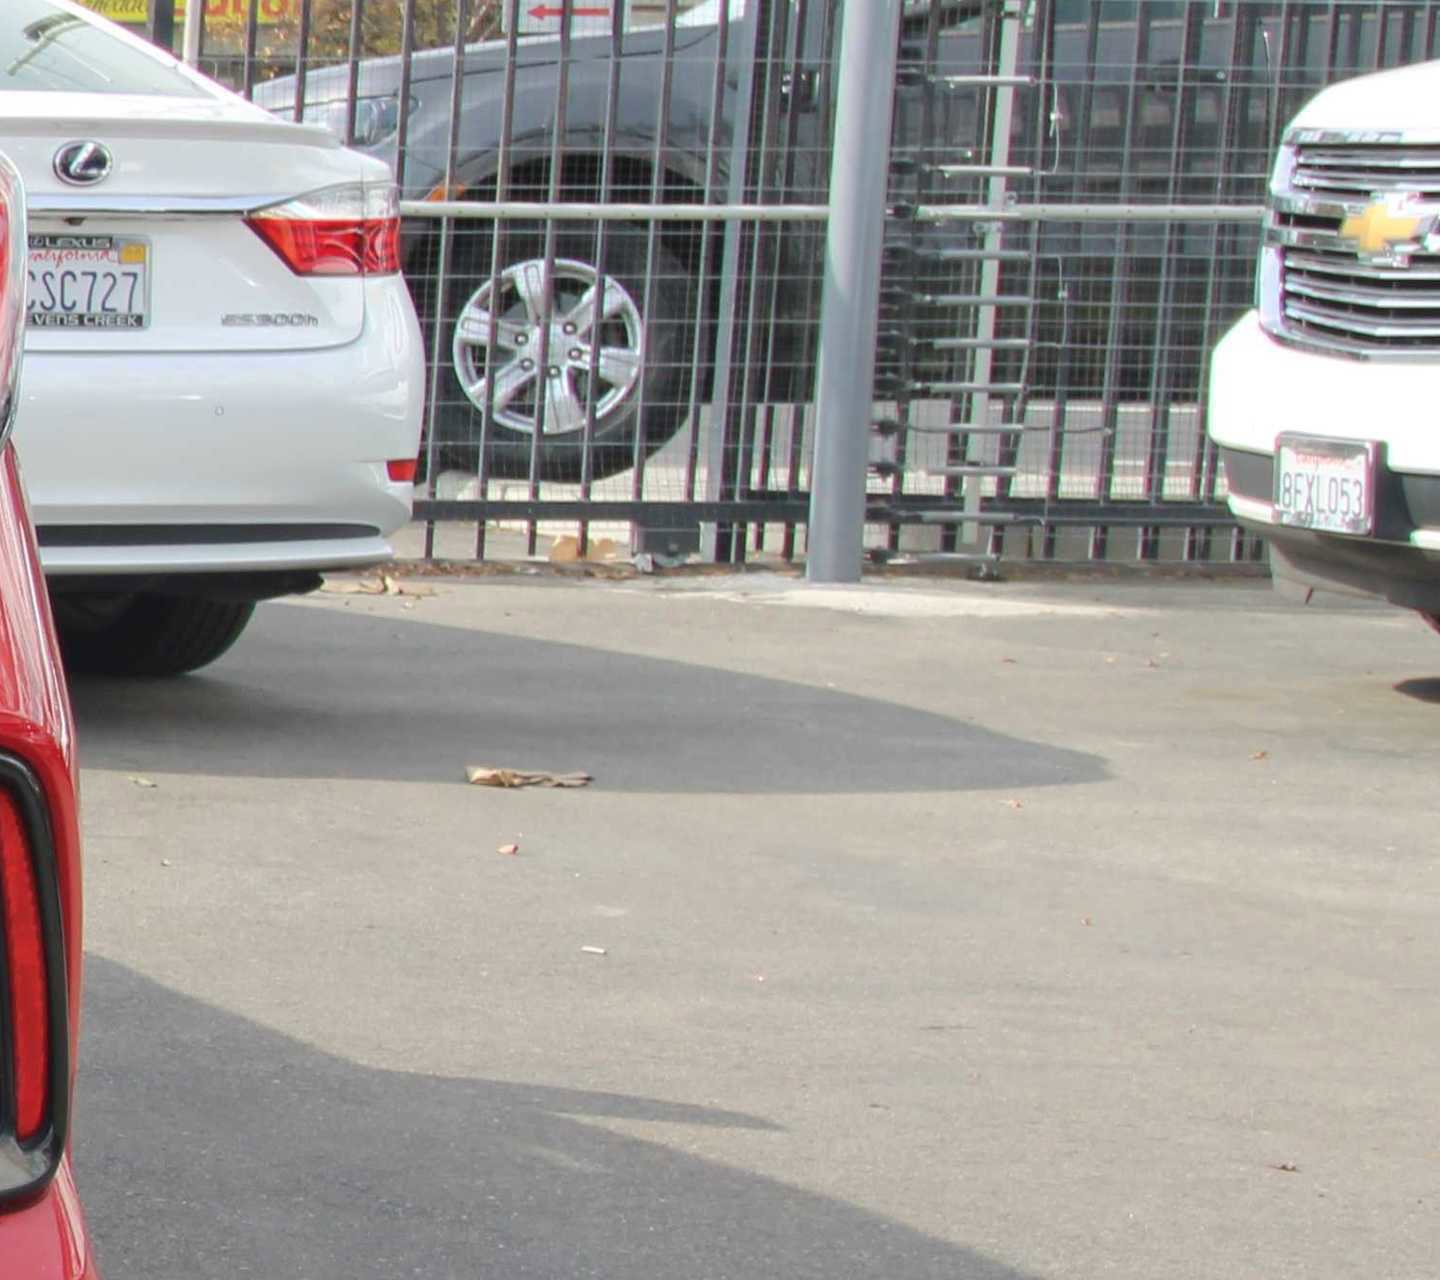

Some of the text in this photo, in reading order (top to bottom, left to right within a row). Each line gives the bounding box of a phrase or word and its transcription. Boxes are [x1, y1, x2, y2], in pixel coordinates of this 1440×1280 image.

[45, 237, 111, 249] LEXUS
[27, 314, 138, 327] VENS CREEK
